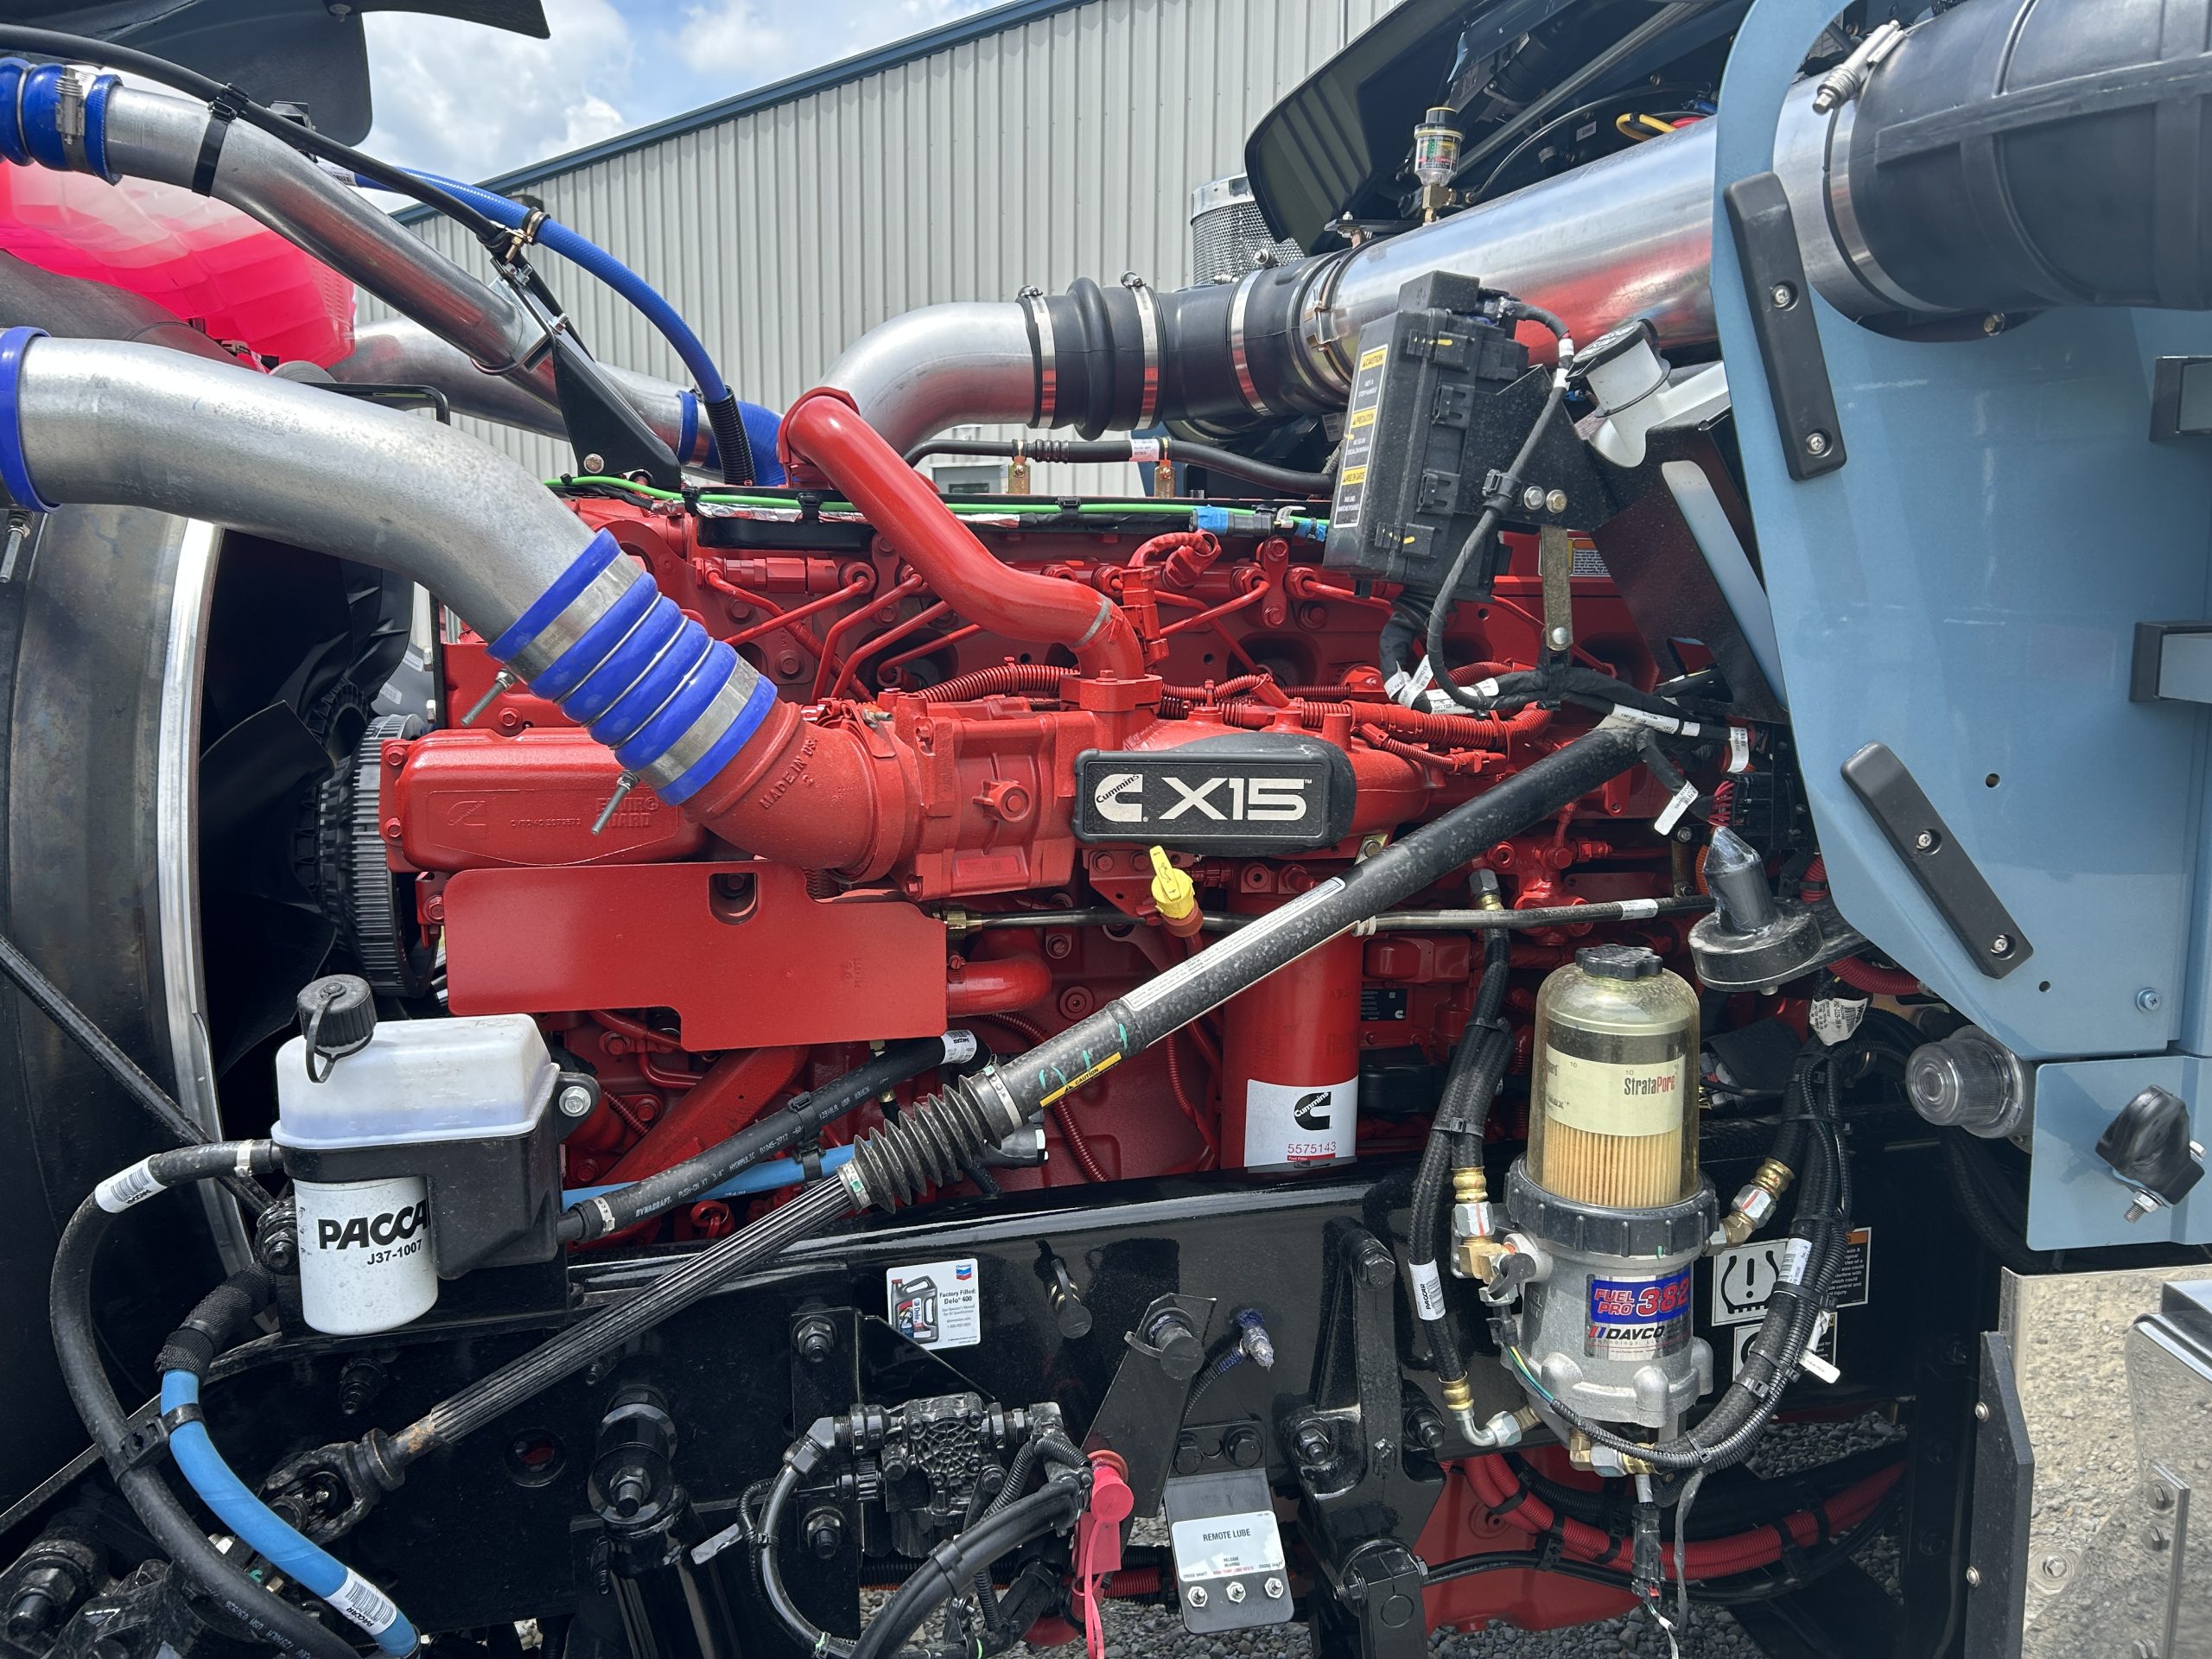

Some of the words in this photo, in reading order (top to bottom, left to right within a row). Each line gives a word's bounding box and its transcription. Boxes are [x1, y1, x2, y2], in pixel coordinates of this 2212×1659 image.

[758, 771, 797, 810] MADE
[790, 754, 809, 773] IN
[1095, 773, 1141, 805] Cummins
[595, 797, 659, 813] EVIRO
[1159, 777, 1308, 822] X15
[1075, 1067, 1099, 1085] CAUTION
[1624, 1075, 1676, 1096] StrataPore
[1294, 1091, 1330, 1118] Cummins
[677, 1182, 701, 1198] PUSH-ON
[712, 1168, 725, 1181] 3/4"
[728, 1151, 757, 1172] HYDRAULIC
[841, 1096, 851, 1108] USA
[1287, 1141, 1337, 1154] 5575143
[317, 1197, 431, 1250] PACCA
[367, 1238, 423, 1266] J37-1007
[1420, 1283, 1432, 1310] PACCAR
[1594, 1287, 1635, 1304] FUEL
[1636, 1277, 1690, 1318] 382
[1598, 1303, 1634, 1316] PRO
[1605, 1325, 1666, 1340] DAVCO
[1202, 1530, 1232, 1542] REMOTE
[1231, 1528, 1252, 1538] LUBE
[249, 1618, 264, 1630] USA
[346, 1606, 375, 1628] PACCAR
